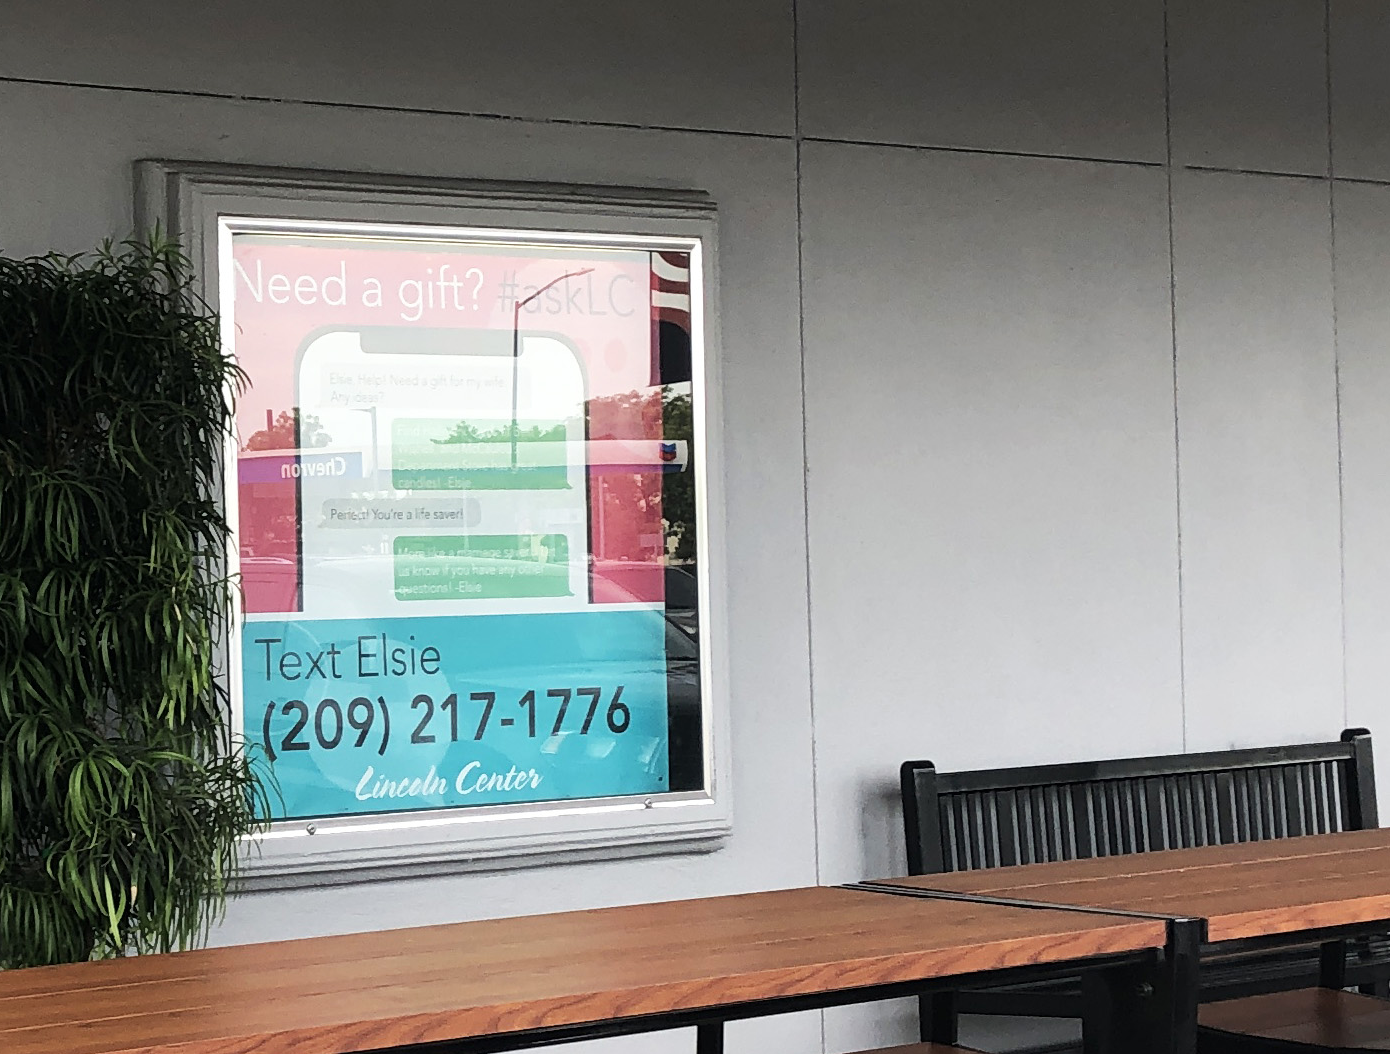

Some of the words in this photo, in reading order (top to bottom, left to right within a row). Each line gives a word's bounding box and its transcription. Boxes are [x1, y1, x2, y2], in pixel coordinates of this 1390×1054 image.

[234, 258, 347, 307] Need
[362, 277, 383, 307] a
[397, 264, 484, 321] gift?
[497, 269, 636, 317] #askLC
[389, 373, 419, 386] Need
[330, 391, 349, 406] Any
[371, 508, 404, 520] You're
[406, 511, 413, 520] a
[414, 507, 430, 520] life
[433, 507, 464, 520] saver!
[412, 566, 440, 577] know
[442, 564, 450, 576] if
[451, 567, 470, 579] you
[472, 564, 496, 575] have
[498, 567, 516, 579] any
[255, 638, 342, 682] Text
[357, 632, 441, 679] Elsie
[262, 695, 391, 763] (209)
[410, 685, 631, 744] 217-1776
[355, 765, 448, 802] Lincoln
[455, 760, 544, 796] Center
